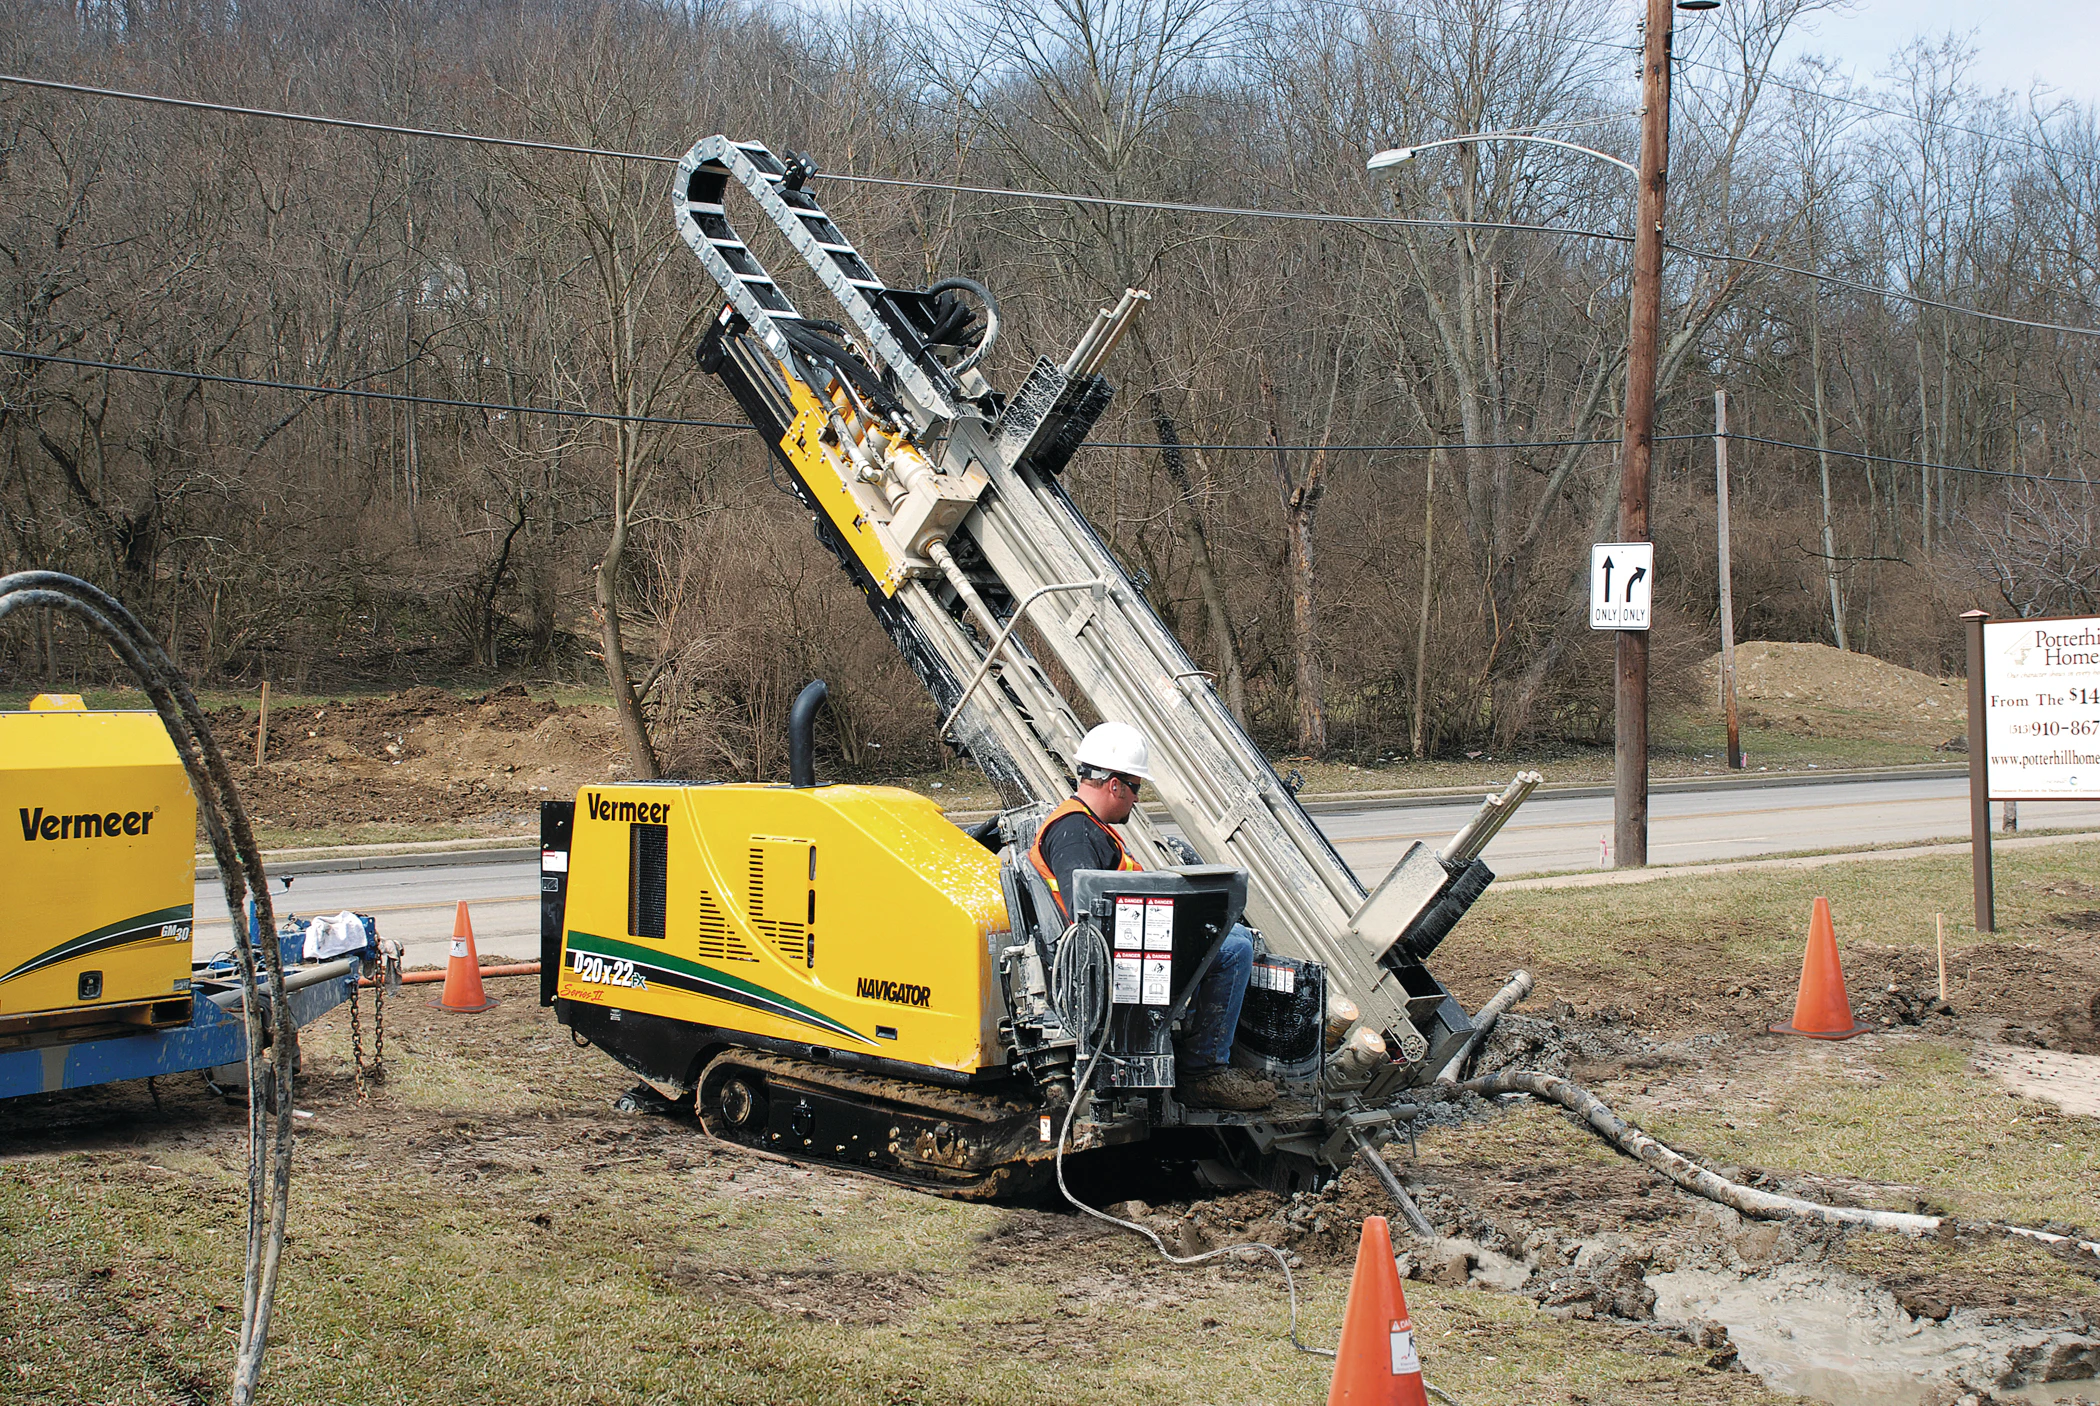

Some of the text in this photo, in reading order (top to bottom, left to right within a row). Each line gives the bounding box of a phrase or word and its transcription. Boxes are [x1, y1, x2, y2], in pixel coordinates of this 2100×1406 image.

[1595, 608, 1617, 621] ONLY
[1623, 608, 1646, 621] ONLY
[2045, 648, 2100, 667] Home
[1990, 695, 2029, 708] From
[2035, 693, 2065, 706] The
[587, 792, 671, 824] Vermeer
[19, 807, 154, 842] Vermeer
[160, 924, 190, 942] GM30
[560, 983, 593, 1000] Series
[856, 977, 931, 1008] NAVIGATOR
